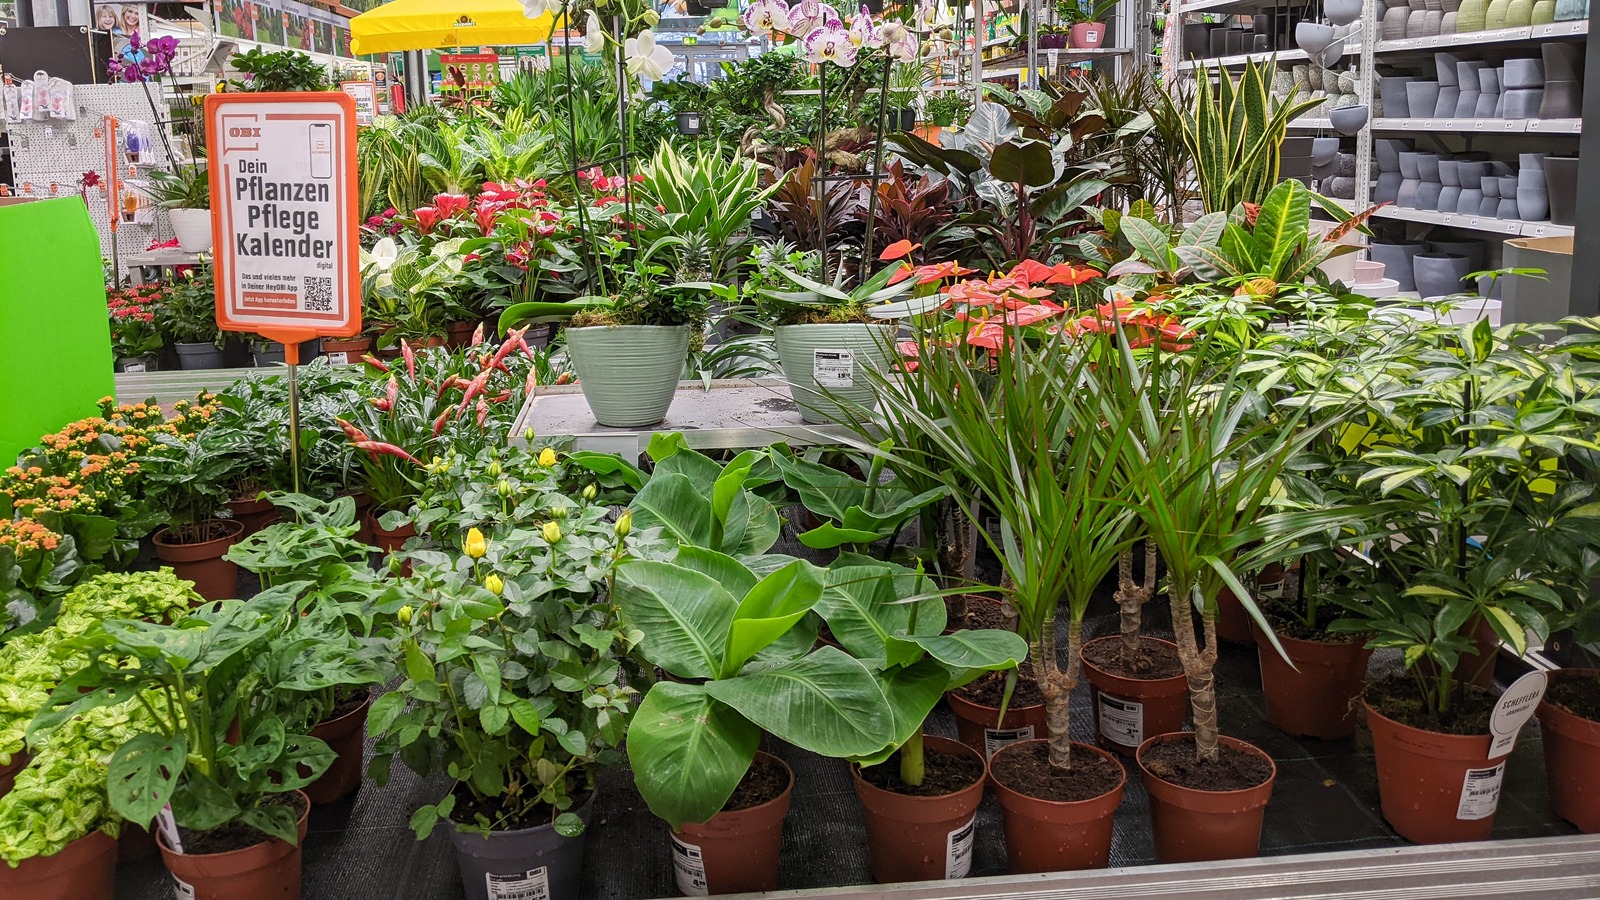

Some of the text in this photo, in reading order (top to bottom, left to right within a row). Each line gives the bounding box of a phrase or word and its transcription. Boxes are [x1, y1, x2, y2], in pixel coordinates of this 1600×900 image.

[229, 127, 261, 138] OBI
[239, 159, 267, 174] Dein
[236, 176, 329, 202] Pflanzen
[248, 204, 319, 235] Pflege
[237, 232, 333, 259] Kalender
[317, 262, 333, 270] digital
[264, 273, 281, 281] vieles
[282, 274, 296, 282] mehr
[248, 282, 264, 290] Deiner
[265, 283, 286, 291] HeyOBI
[287, 284, 298, 292] App
[263, 297, 296, 305] herunterladen
[1503, 692, 1539, 709] SCHEFFLERA
